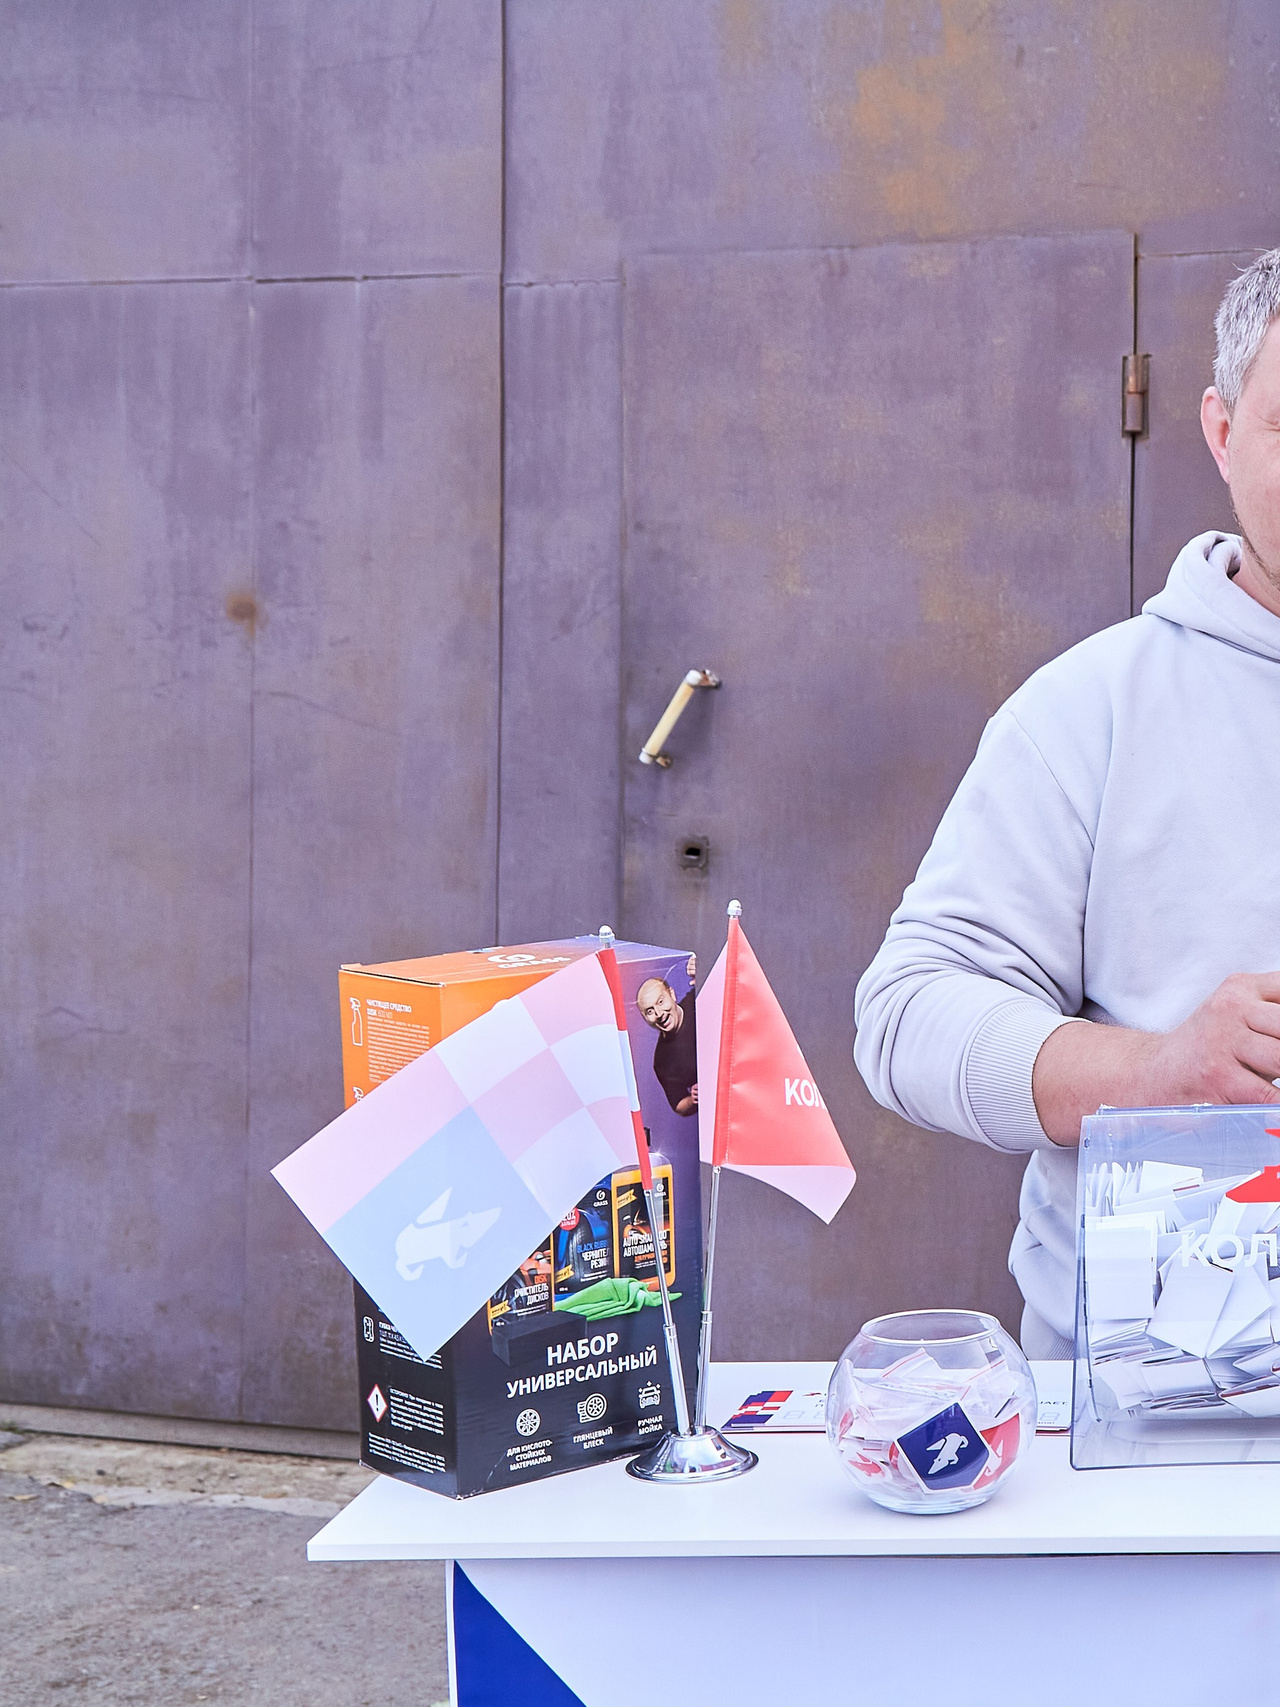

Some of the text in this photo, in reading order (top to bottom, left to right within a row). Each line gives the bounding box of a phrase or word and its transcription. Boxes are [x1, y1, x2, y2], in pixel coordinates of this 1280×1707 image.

[526, 1292, 549, 1305] ДИСКОВ
[547, 1332, 618, 1366] НАБОР
[506, 1344, 658, 1398] УНИВЕРСАЛЬНЫЙ
[637, 1415, 663, 1427] РУЧНАЯ
[573, 1426, 613, 1444] ГЛЯНЦЕВЫЙ
[638, 1423, 663, 1435] МОЙКА
[583, 1438, 604, 1449] БЛЕСК
[506, 1446, 521, 1457] ДЛЯ
[515, 1448, 546, 1462] СТОЙКИХ
[509, 1455, 552, 1471] МАТЕРИАЛОВ
